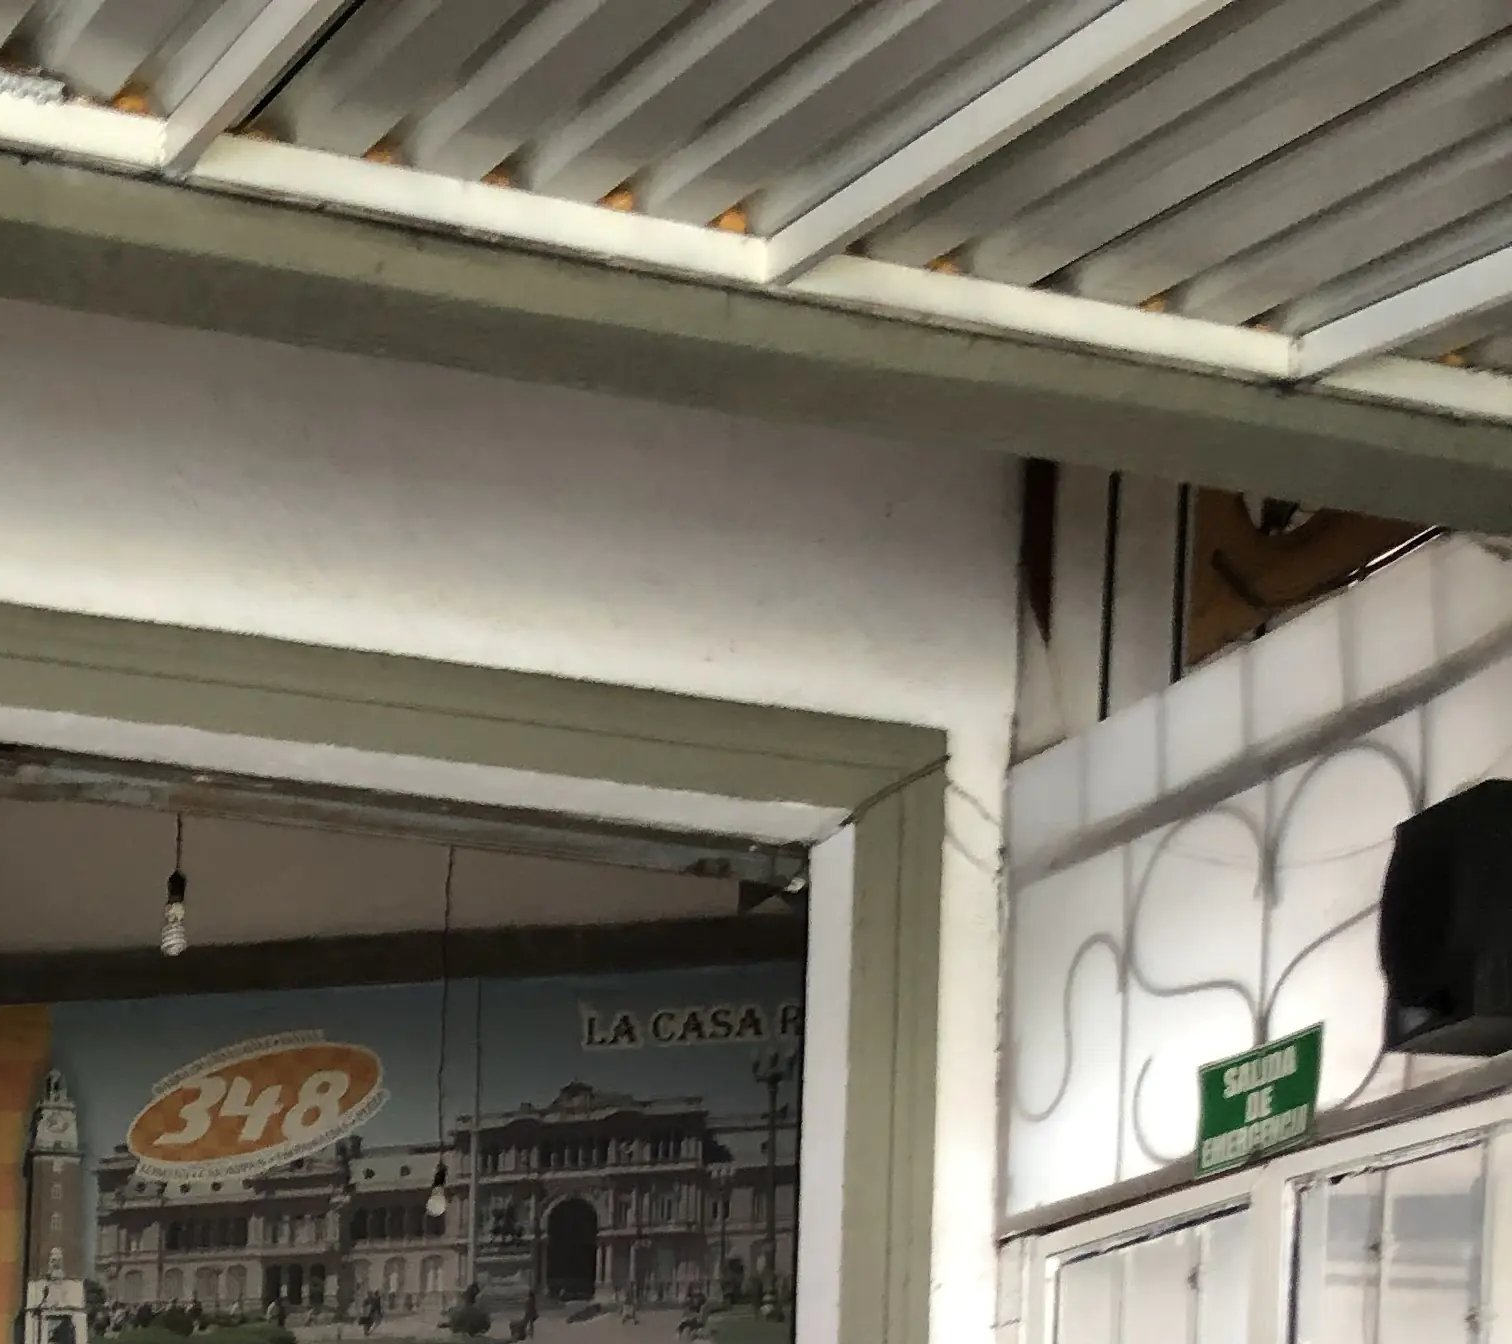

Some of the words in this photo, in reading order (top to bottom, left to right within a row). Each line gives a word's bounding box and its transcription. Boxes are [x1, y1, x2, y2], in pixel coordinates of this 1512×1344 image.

[586, 1014, 637, 1046] LA
[650, 1006, 764, 1043] CASA
[1222, 1044, 1298, 1100] SALIDA
[153, 1069, 350, 1146] 348
